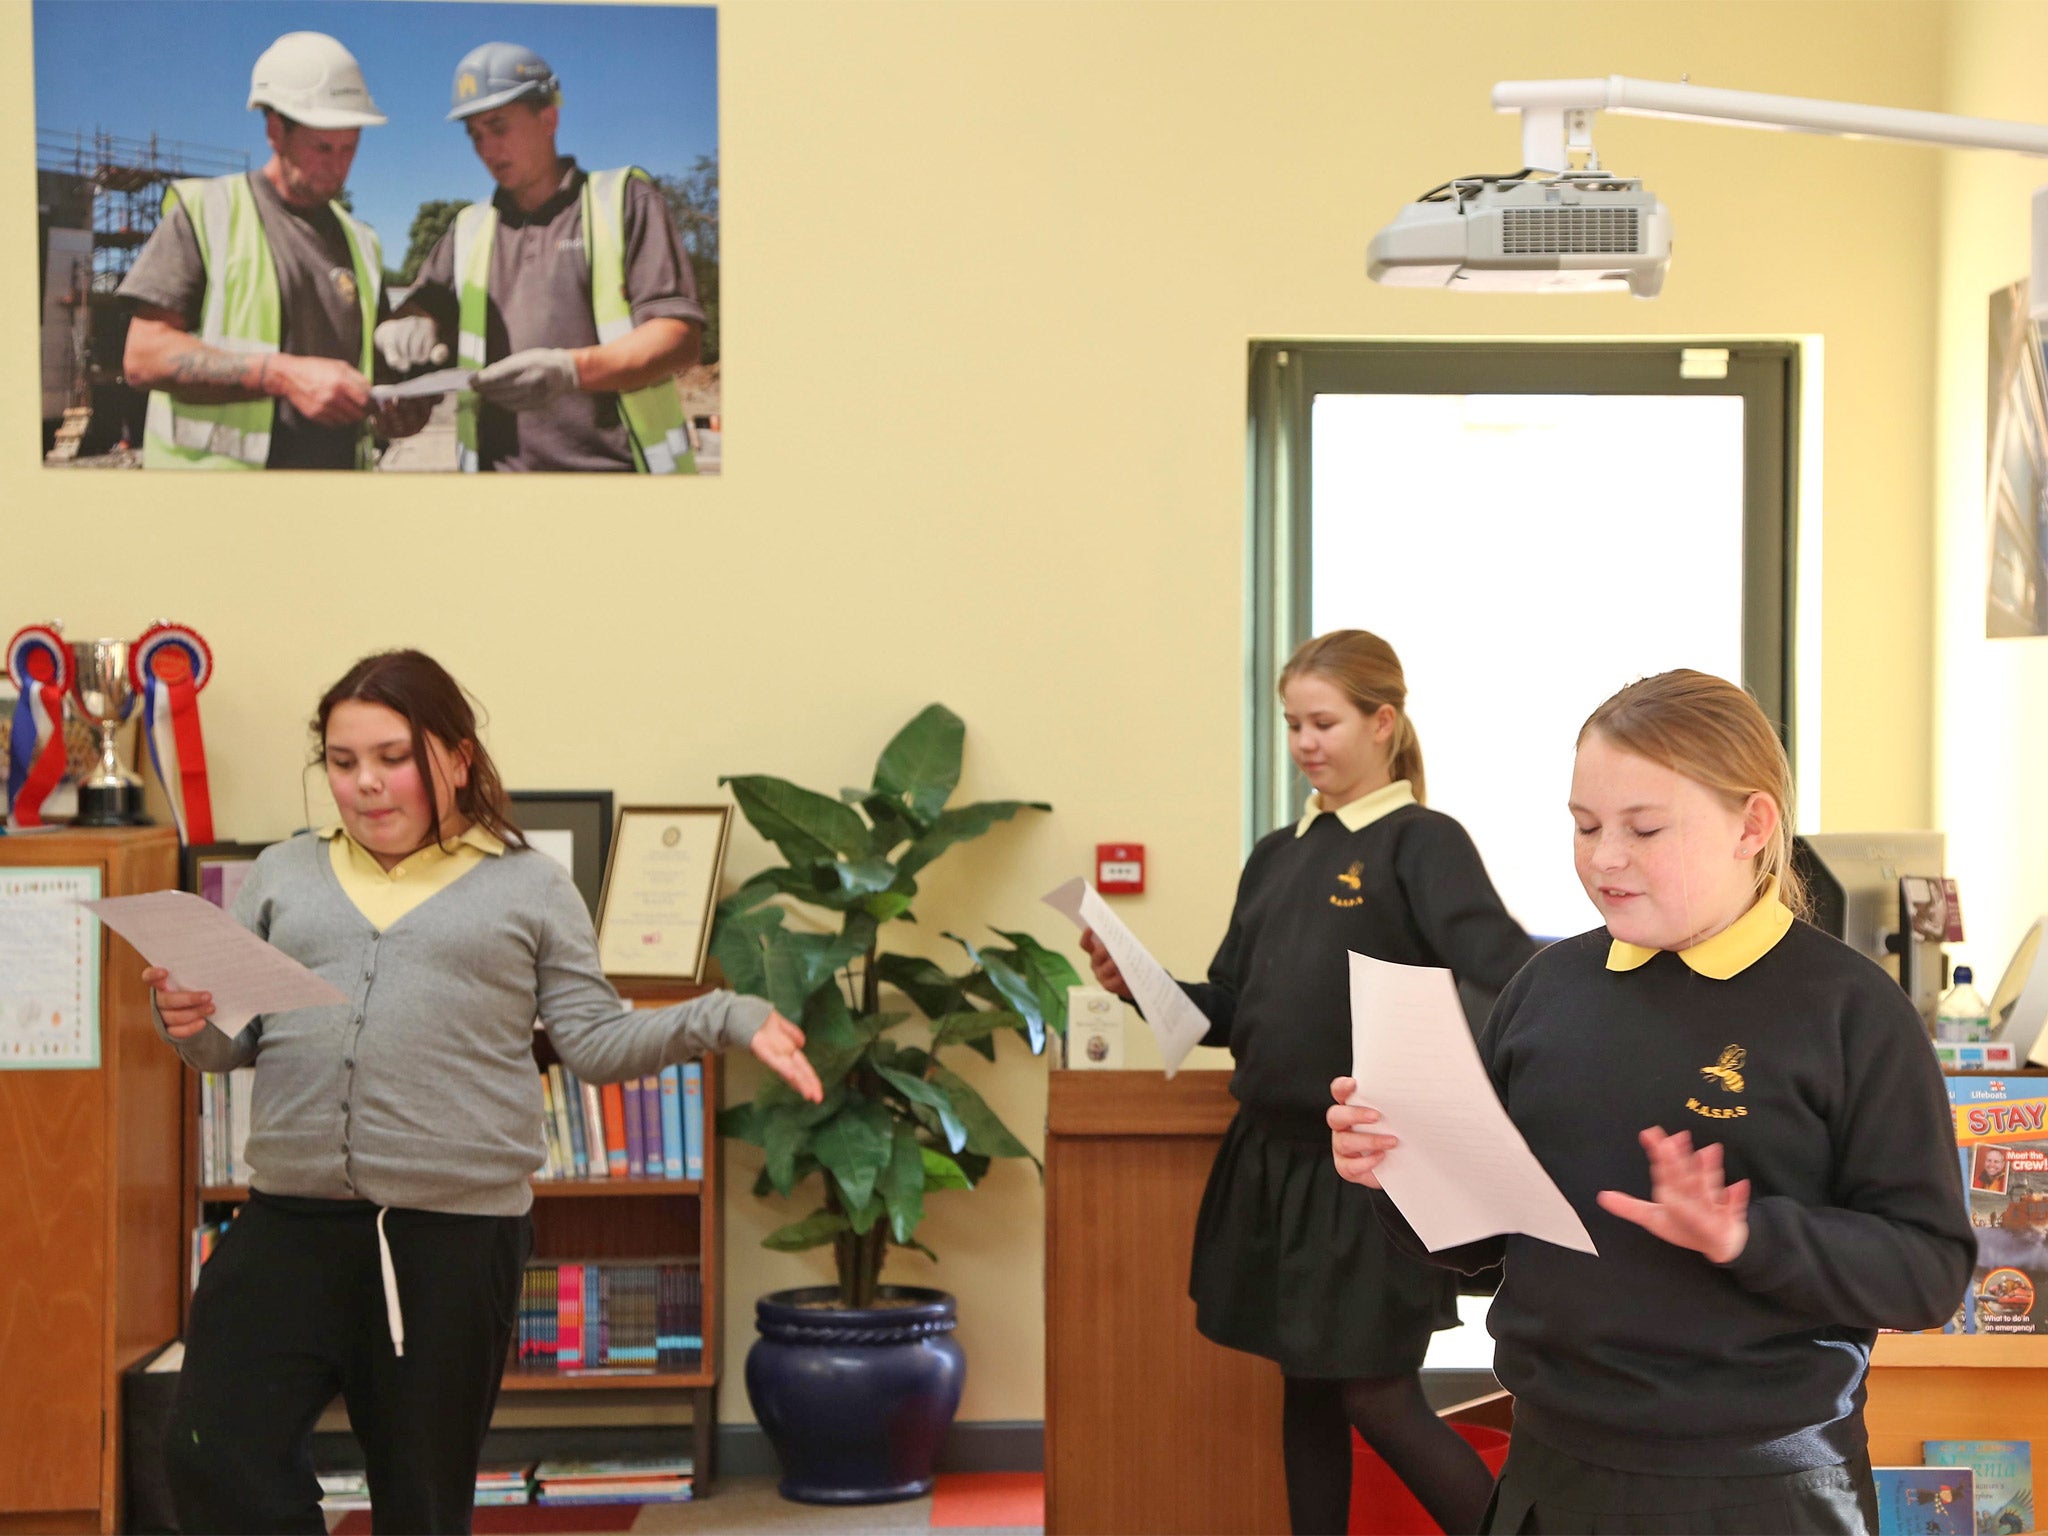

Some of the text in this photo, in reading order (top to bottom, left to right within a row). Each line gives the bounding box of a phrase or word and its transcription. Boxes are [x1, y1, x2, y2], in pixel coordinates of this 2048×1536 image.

[1971, 1090, 2007, 1099] Lifeboats
[1968, 1102, 2045, 1135] STAY
[2007, 1151, 2043, 1159] Meet the
[2013, 1159, 2048, 1171] crew!
[1995, 1324, 2035, 1332] emergency!
